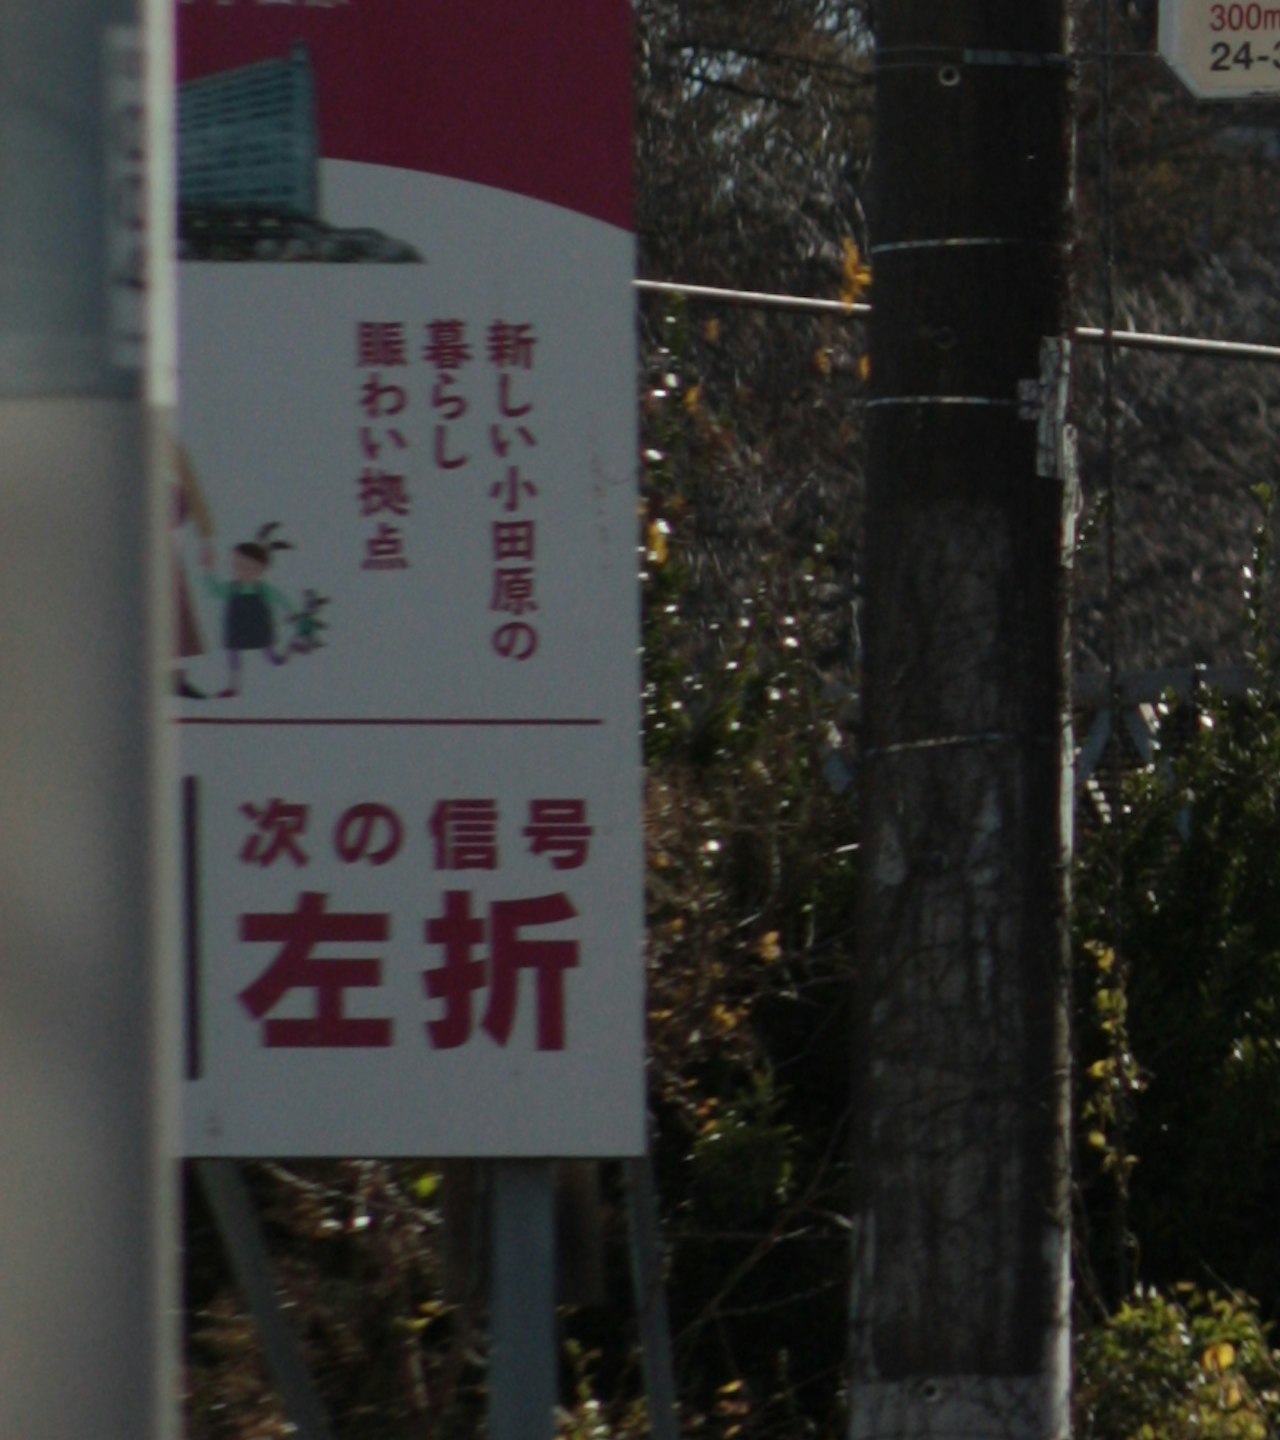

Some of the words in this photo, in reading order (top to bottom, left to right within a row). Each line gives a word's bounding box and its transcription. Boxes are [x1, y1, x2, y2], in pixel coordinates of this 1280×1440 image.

[356, 320, 410, 572] 賑わい拠点
[422, 320, 473, 472] 暮らし
[486, 320, 541, 663] 新しい小田原の
[237, 797, 595, 872] 次の信号
[236, 889, 582, 1053] 左折
